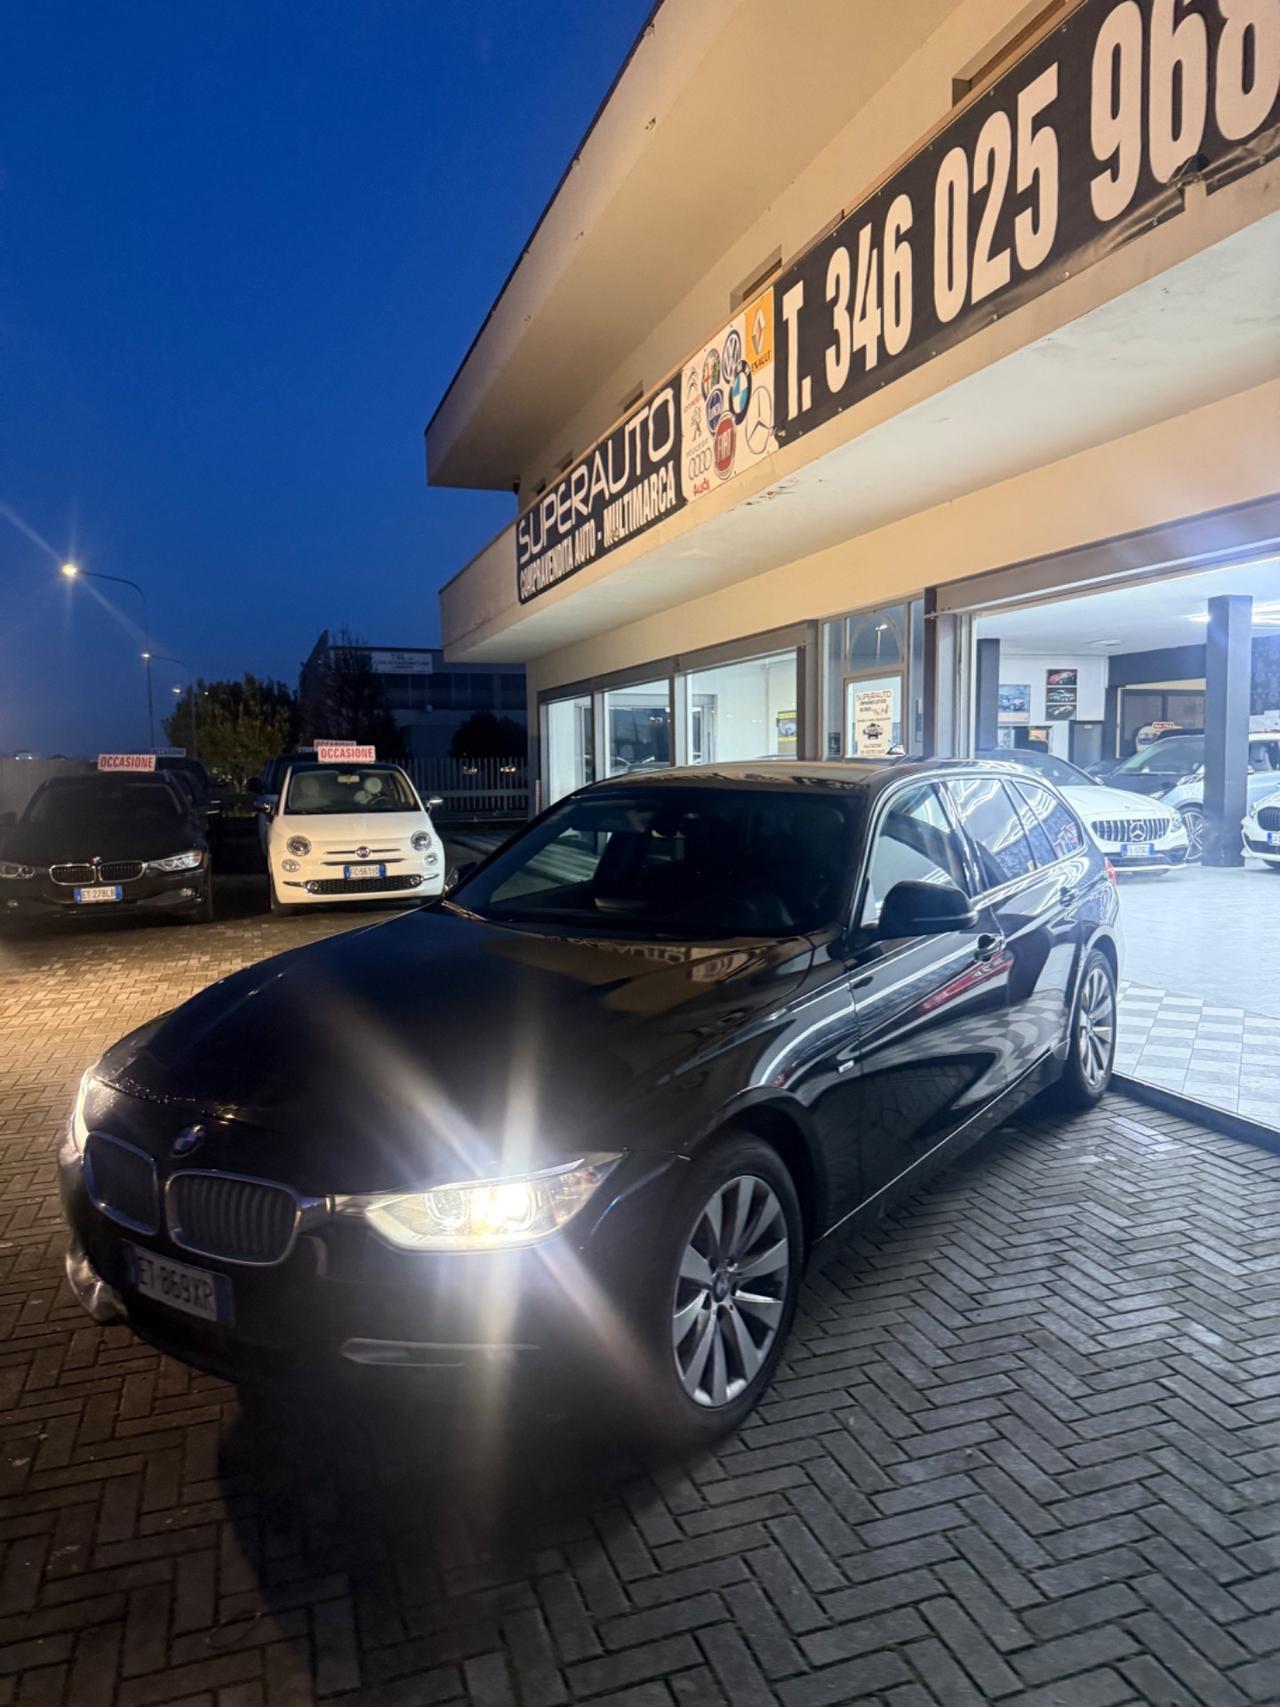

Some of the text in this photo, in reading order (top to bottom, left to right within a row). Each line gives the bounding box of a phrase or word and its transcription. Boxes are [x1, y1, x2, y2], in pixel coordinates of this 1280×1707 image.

[782, 280, 812, 421] T.
[825, 193, 913, 393] 346
[934, 61, 1059, 324] 025
[518, 386, 675, 565] SUPERAUTO
[692, 478, 710, 496] Audi
[574, 518, 596, 567] AUTO
[603, 460, 676, 549] MULTIMARCA
[100, 756, 153, 769] OCCASIONE
[320, 748, 374, 759] OCCASIONE
